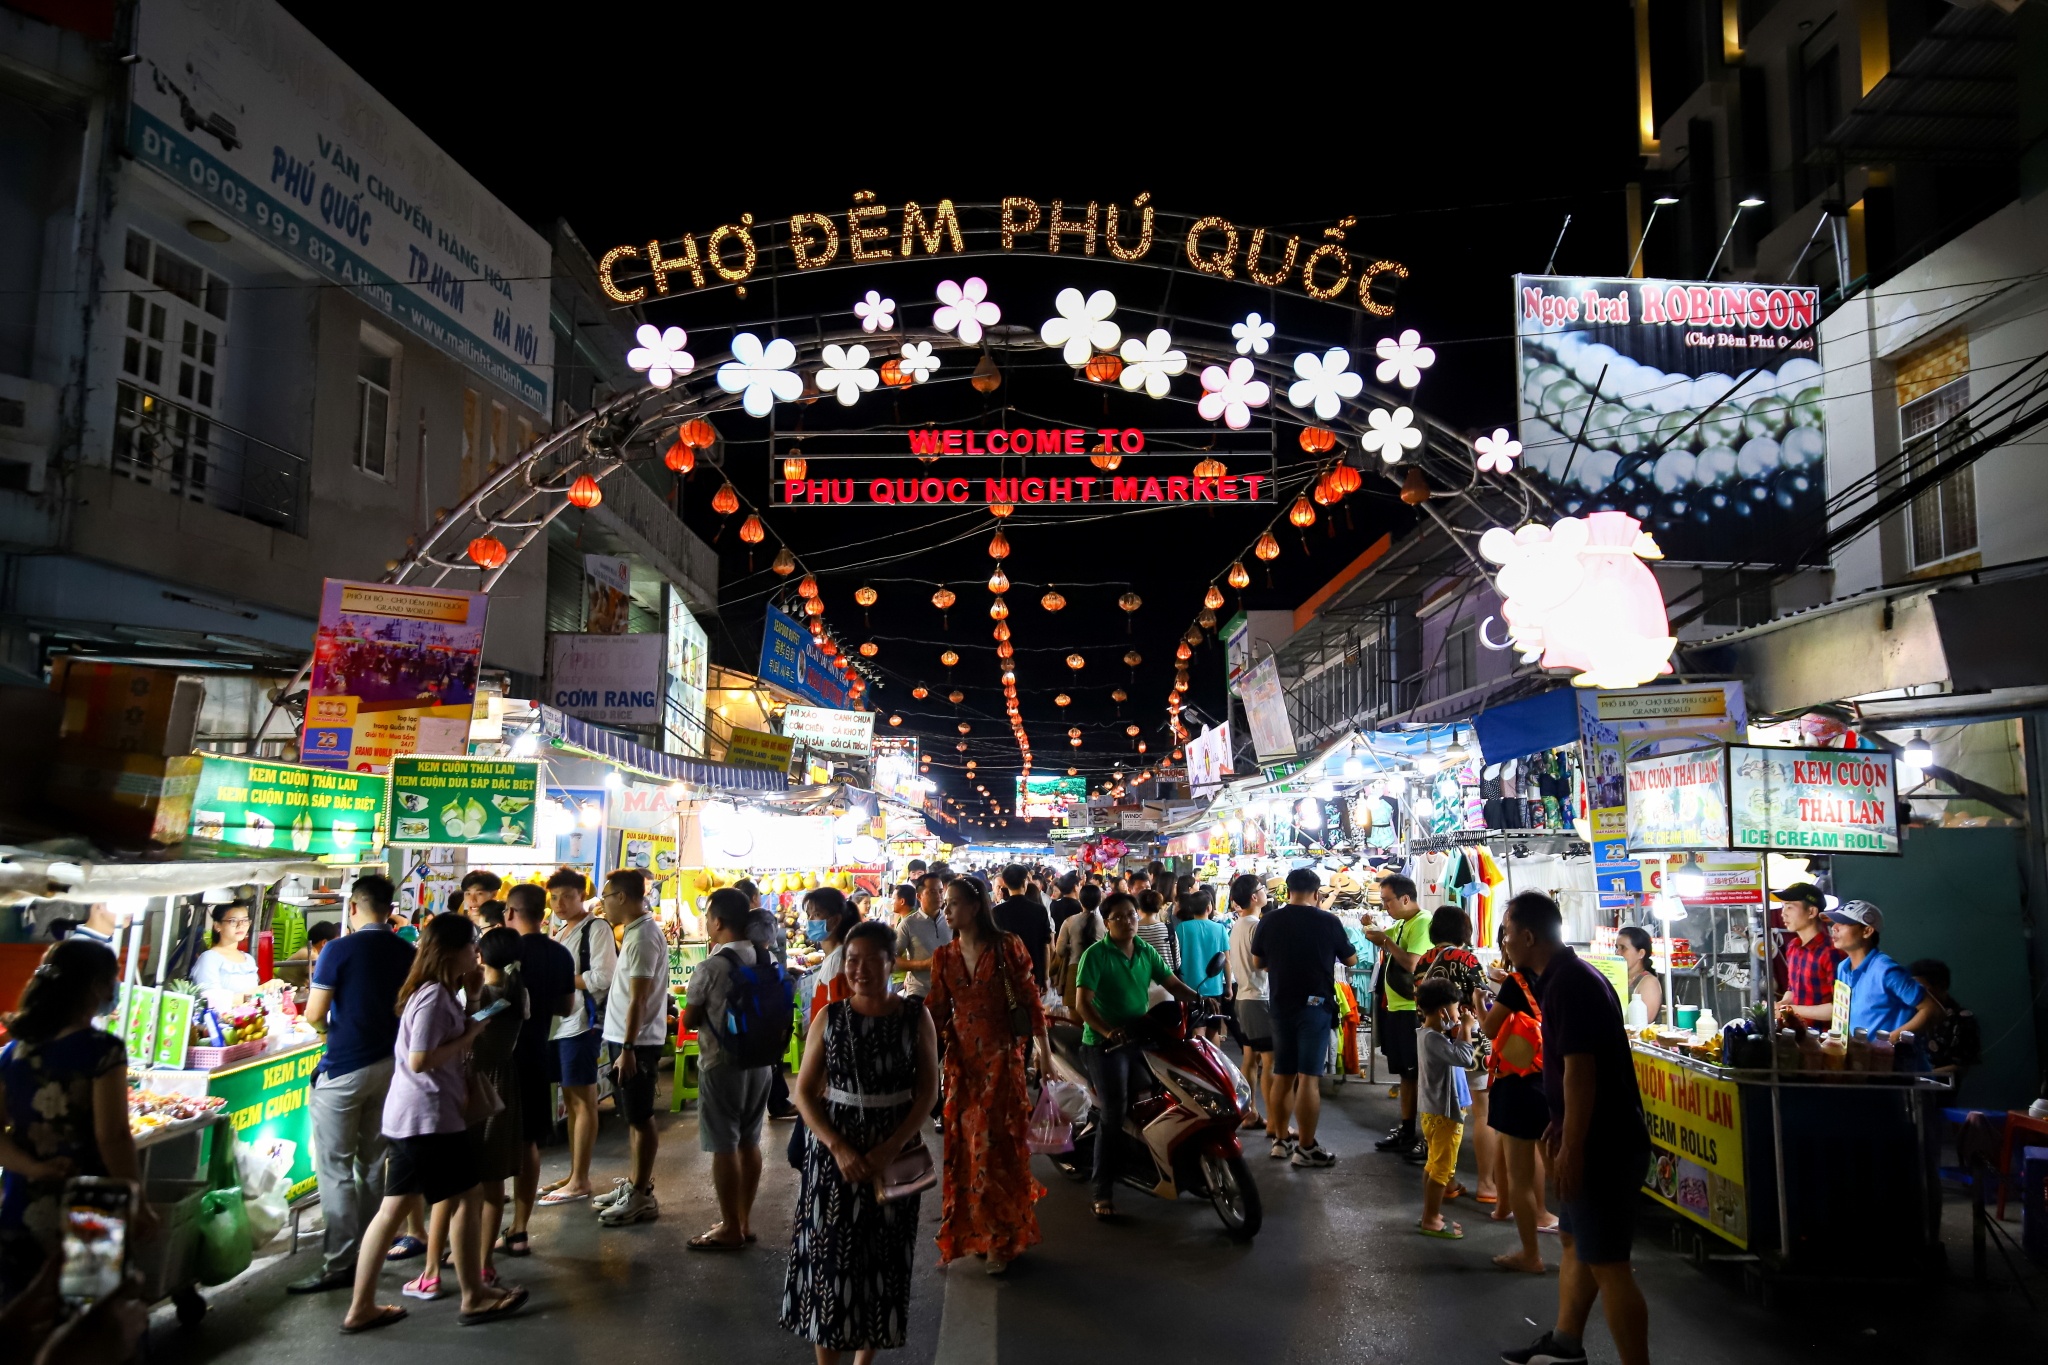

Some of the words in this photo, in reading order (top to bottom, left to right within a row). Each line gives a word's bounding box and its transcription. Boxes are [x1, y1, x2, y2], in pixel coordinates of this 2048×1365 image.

[142, 125, 182, 171] ĐT:
[189, 155, 248, 215] 0903
[255, 203, 300, 248] 999
[308, 235, 336, 272] 812
[341, 261, 393, 310] A.Hùng
[317, 132, 360, 186] VẬN
[367, 172, 432, 242] CHUYỂN
[438, 227, 479, 276] HÀNG
[484, 257, 513, 302] HÓA
[271, 144, 316, 208] PHÚ
[320, 181, 371, 248] QUỐC
[408, 243, 464, 314] TP.HCM
[493, 306, 511, 347] HÀ
[514, 323, 538, 364] NỘI
[600, 212, 756, 302] CHỢ
[790, 190, 964, 270] ĐÊM
[1001, 191, 1154, 261] PHÚ
[1186, 215, 1409, 316] QUỐC
[1523, 286, 1579, 327] Ngọc
[1582, 289, 1631, 324] Trai
[1639, 284, 1815, 330] ROBINSON
[1685, 331, 1716, 350] (Chợ
[1717, 332, 1748, 348] Đêm
[1749, 331, 1775, 349] Phú
[908, 429, 1085, 455] WELCOME
[1098, 428, 1145, 454] TO
[785, 478, 854, 504] PHU
[869, 478, 970, 505] QUOC
[985, 476, 1096, 503] NIGHT
[1112, 475, 1265, 502] MARKET
[376, 604, 404, 613] GRAND
[406, 606, 434, 616] WORLD
[318, 700, 348, 717] 100
[555, 688, 598, 708] CƠM
[604, 690, 656, 708] RANG
[577, 709, 607, 720] FRIED
[609, 710, 633, 720] RICE
[853, 714, 871, 724] CHUA
[1633, 707, 1661, 716] GRAND
[1662, 705, 1691, 714] WORLD
[317, 731, 339, 749] 23
[354, 747, 372, 757] GRAND
[418, 761, 440, 772] KEM
[442, 760, 469, 775] CUỘN
[495, 763, 516, 775] LAN
[1629, 769, 1647, 793] KEM
[1648, 761, 1672, 797] CUỘN
[1673, 757, 1697, 788] THÁI
[1699, 758, 1720, 785] LAN
[1793, 759, 1834, 786] KEM
[1837, 757, 1888, 797] CUỘN
[248, 767, 277, 785] KEM
[279, 769, 310, 789] CUỘN
[312, 773, 336, 790] THÁI
[337, 777, 359, 792] LAN
[395, 775, 418, 787] KEM
[420, 775, 446, 789] CUỘN
[470, 776, 490, 789] SÁP
[512, 778, 535, 792] BIỆT
[217, 785, 248, 803] KEM
[250, 788, 284, 808] CUỘN
[311, 792, 333, 808] SÁP
[333, 794, 353, 812] ĐẶC
[354, 796, 376, 813] BIỆT
[1598, 812, 1626, 828] 100
[1798, 797, 1846, 825] THÁI
[1849, 800, 1886, 825] LAN
[1643, 829, 1656, 845] ICE
[1656, 829, 1682, 845] CREAM
[1741, 828, 1770, 846] ICE
[1775, 830, 1838, 849] CREAM
[1844, 832, 1888, 850] ROLL
[1605, 844, 1626, 860] 23
[1611, 877, 1626, 893] 11
[262, 1061, 296, 1091] KEM
[265, 1088, 302, 1121] CUỘN
[1669, 1072, 1702, 1117] THÁI
[1705, 1086, 1734, 1131] LAN
[1680, 1125, 1718, 1166] ROLLS
